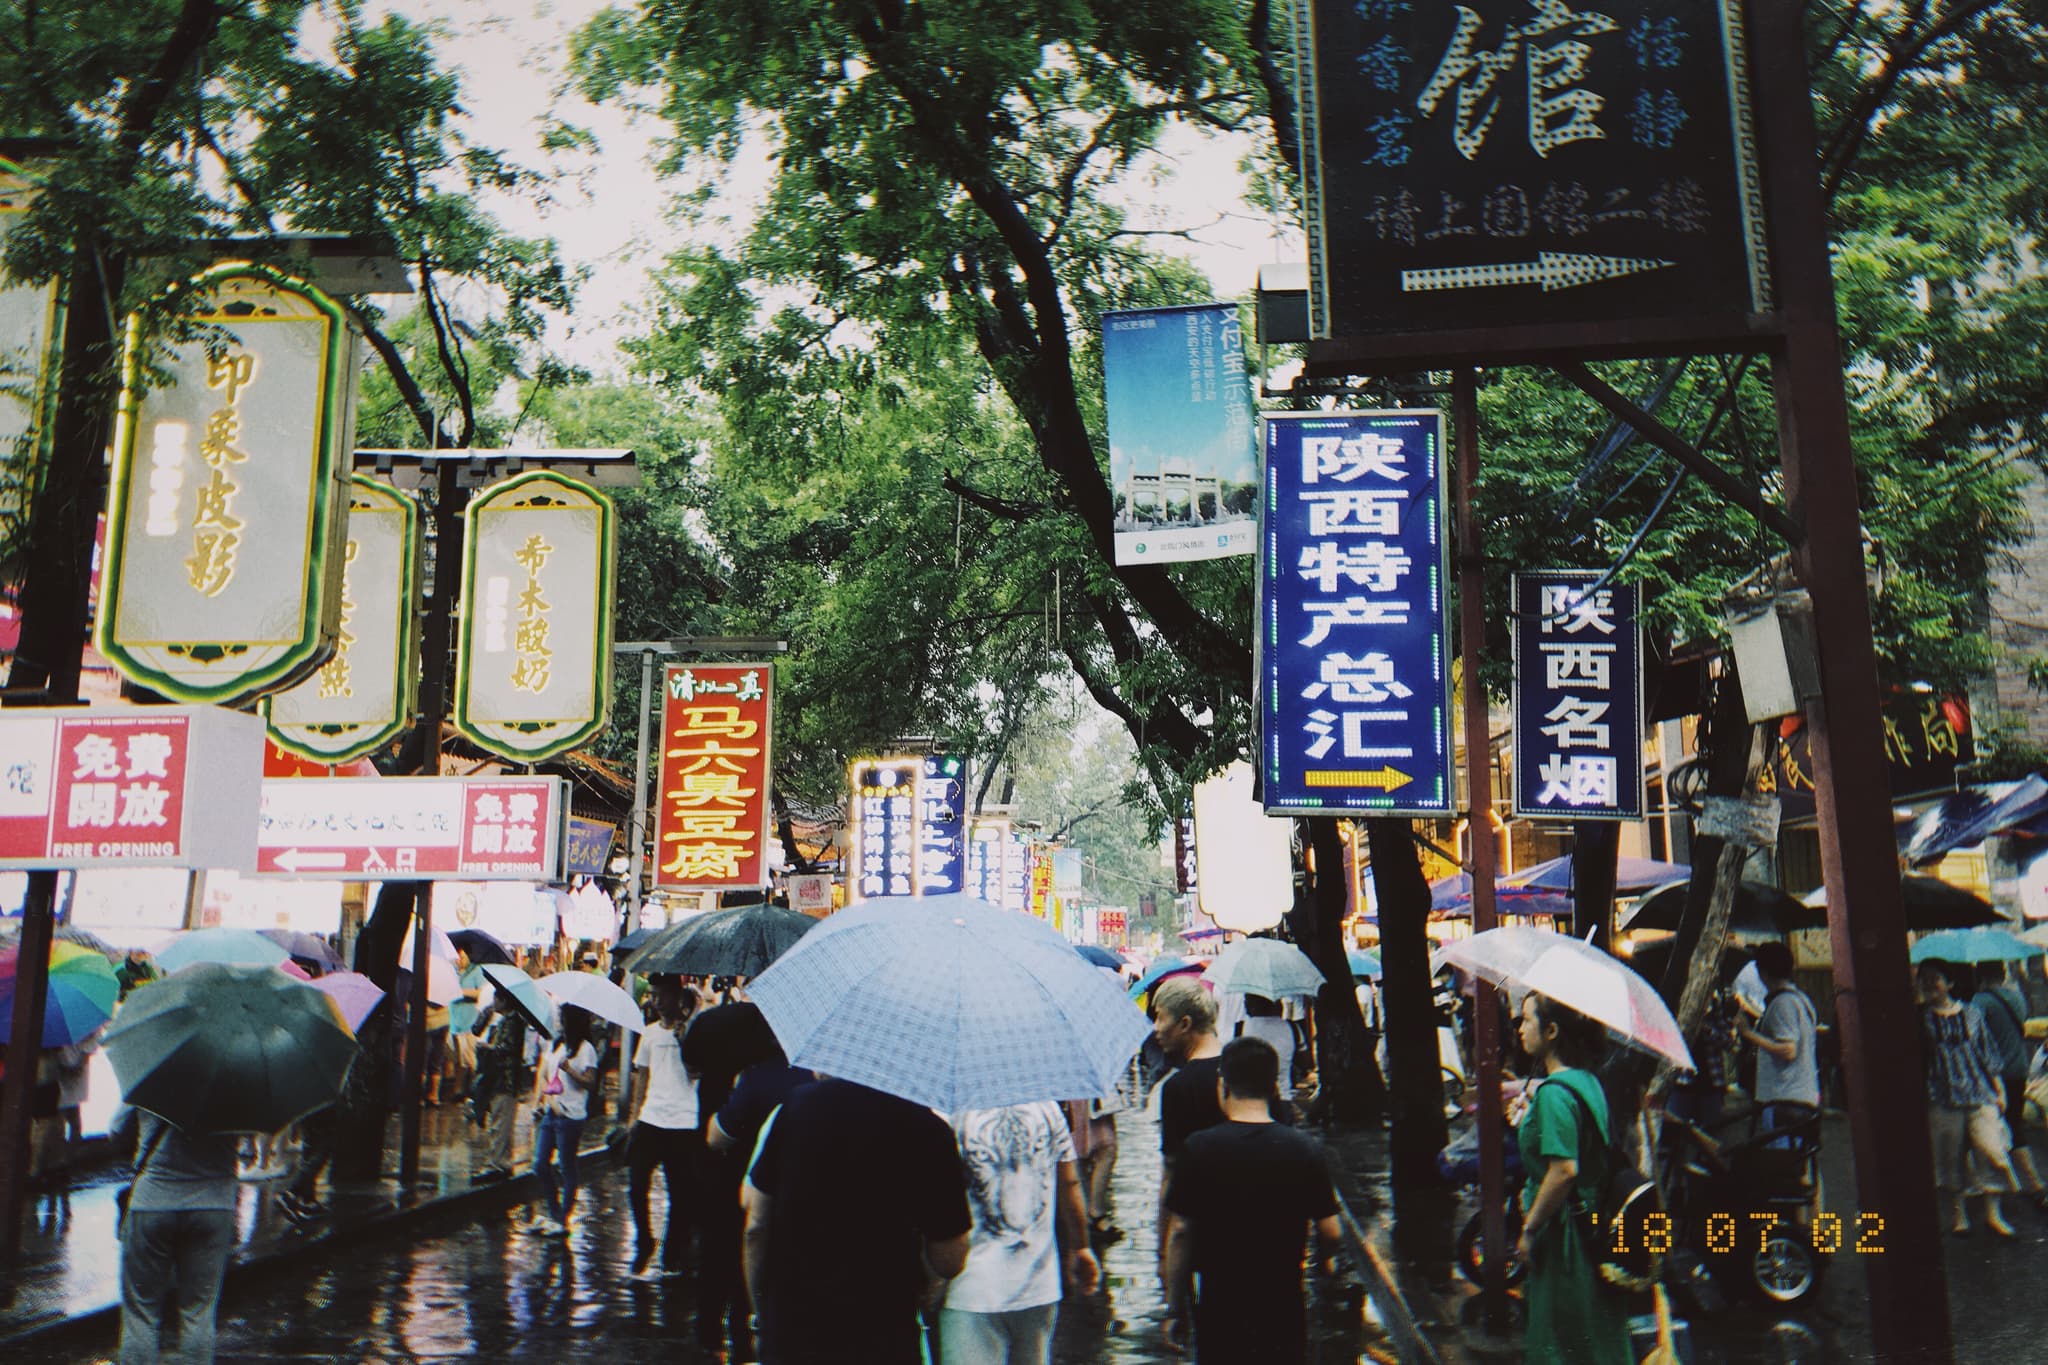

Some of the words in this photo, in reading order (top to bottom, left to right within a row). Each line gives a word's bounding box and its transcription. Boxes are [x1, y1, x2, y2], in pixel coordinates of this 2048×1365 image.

[1417, 0, 1619, 161] 馆
[511, 534, 554, 693] 希木酸奶
[1298, 433, 1414, 761] 陕西特产总汇
[1537, 583, 1617, 808] 陕西名烟
[67, 781, 170, 829] 開放
[72, 731, 172, 780] 免費
[661, 706, 760, 879] 马六臭豆腐
[53, 843, 93, 857] FREE
[99, 841, 175, 857] OPENING
[362, 844, 416, 868] 入口
[462, 862, 489, 873] FREE
[491, 862, 541, 873] OPENING
